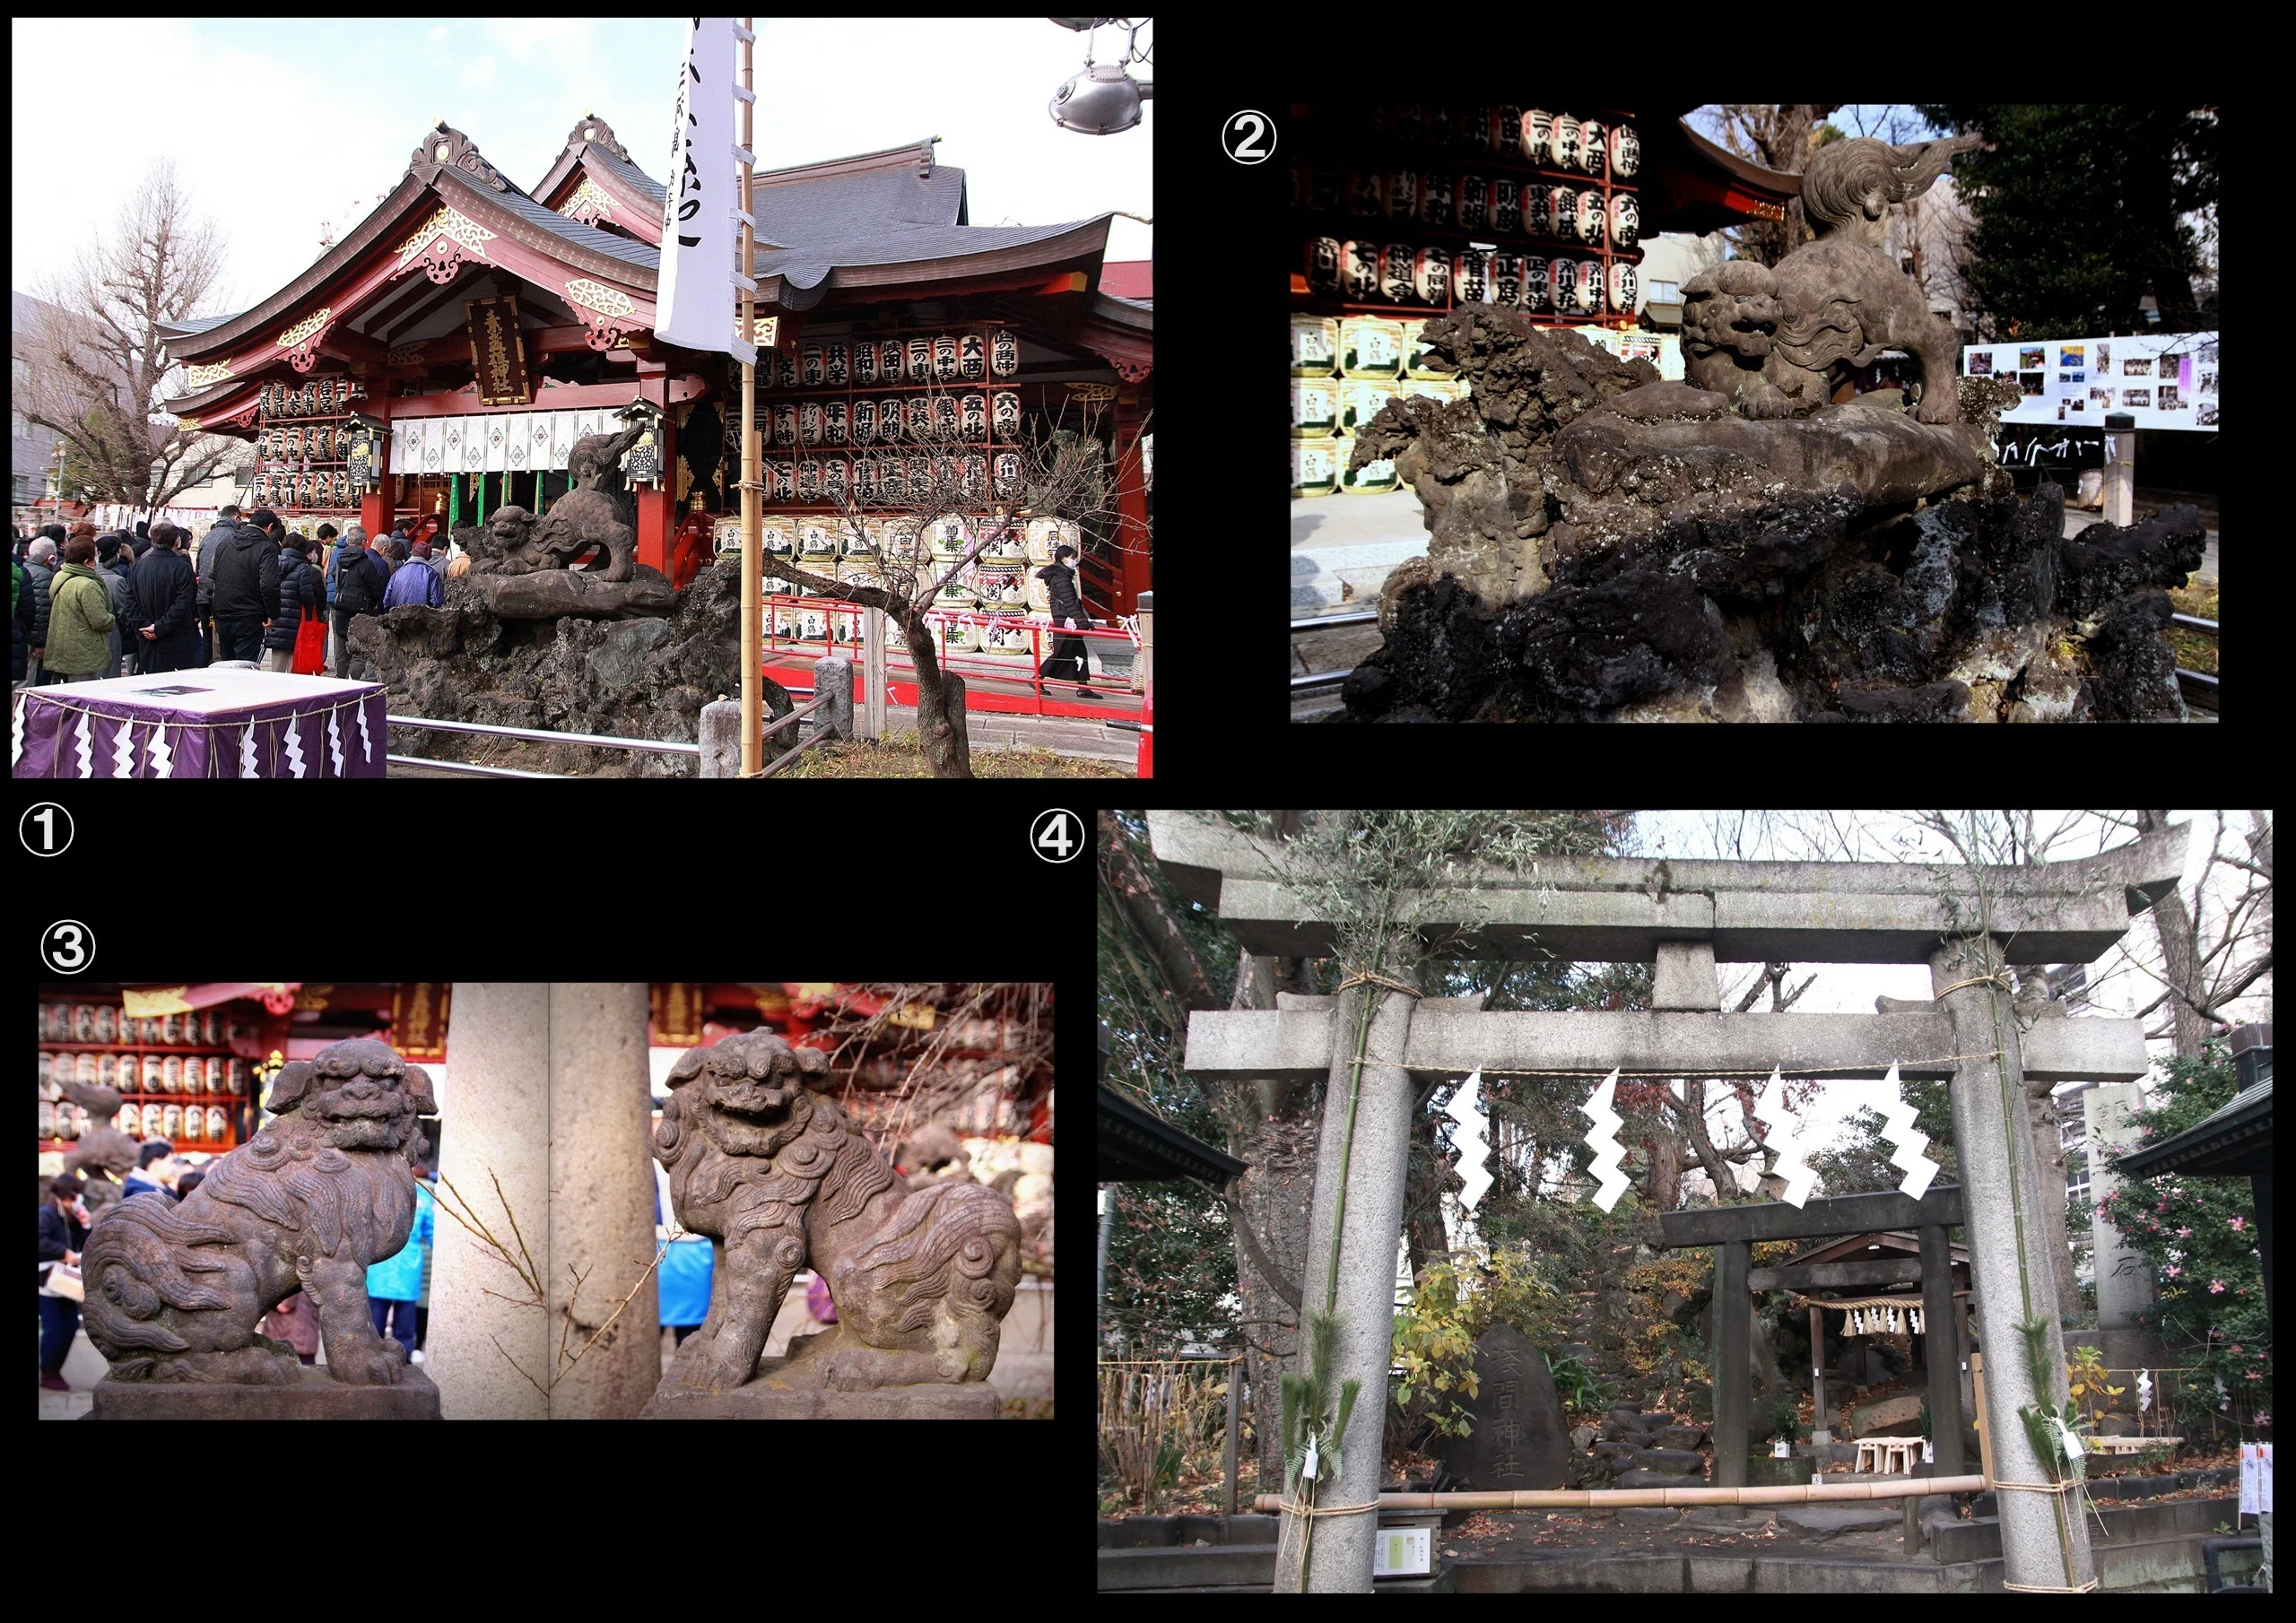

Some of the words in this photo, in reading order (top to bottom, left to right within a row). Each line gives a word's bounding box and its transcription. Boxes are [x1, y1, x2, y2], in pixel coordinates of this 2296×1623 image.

[963, 336, 983, 375] 大西
[964, 397, 984, 438] 五の北
